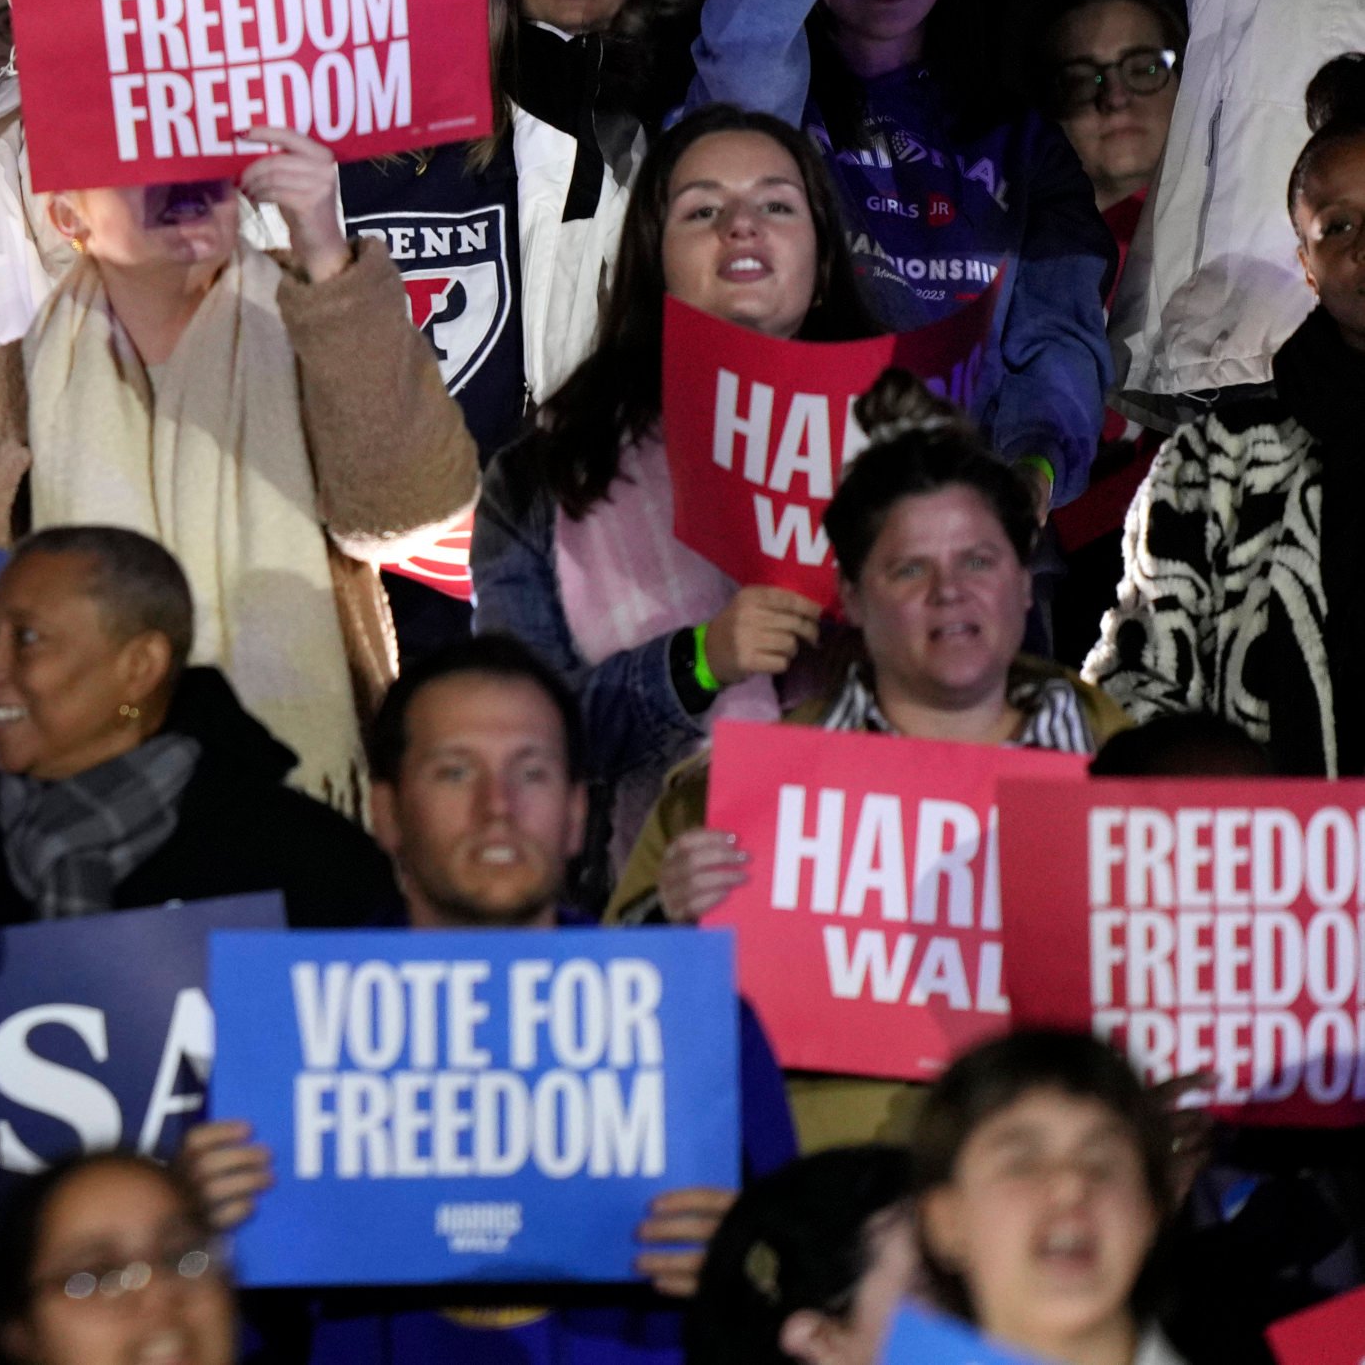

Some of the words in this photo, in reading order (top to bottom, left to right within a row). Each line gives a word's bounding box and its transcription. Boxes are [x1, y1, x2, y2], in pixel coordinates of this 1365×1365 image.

[110, 39, 412, 162] FREEDOM
[866, 195, 920, 219] GIRLS
[929, 201, 949, 216] JR
[1087, 806, 1365, 907] FREEDO
[1091, 909, 1365, 1010] FREEDO
[291, 960, 491, 1070] VOTE
[509, 958, 663, 1070] FOR
[295, 1069, 665, 1180] FREEDOM
